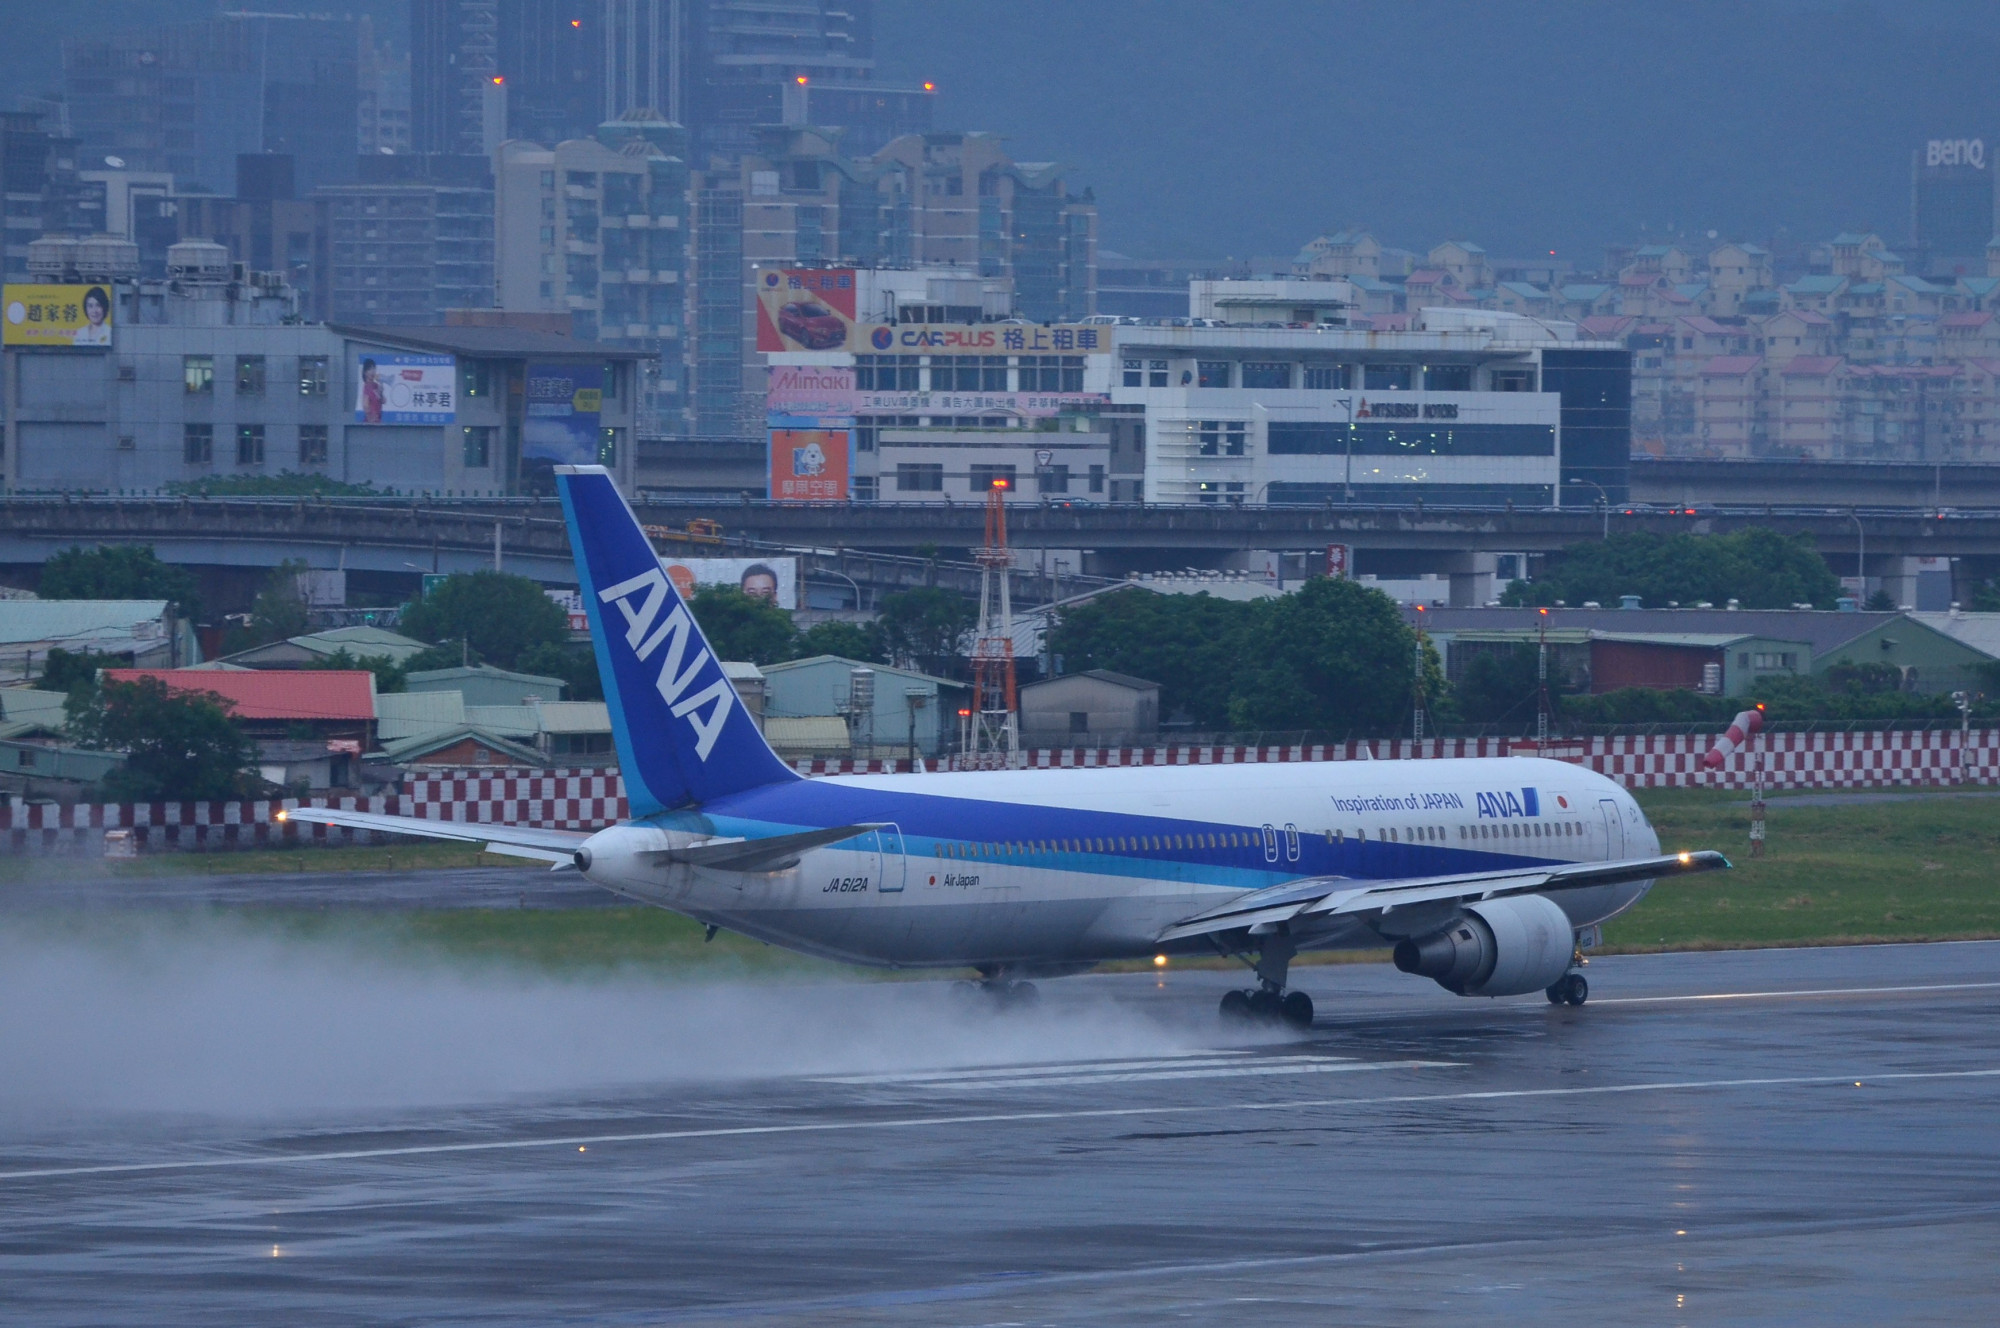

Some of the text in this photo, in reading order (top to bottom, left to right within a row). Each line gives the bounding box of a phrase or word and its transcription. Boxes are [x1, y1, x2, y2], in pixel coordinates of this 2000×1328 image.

[1927, 138, 1985, 169] BenQ
[788, 275, 852, 290] 格上租車
[901, 331, 996, 348] CARPLUS
[1003, 328, 1098, 350] 格上租車
[777, 372, 849, 390] Mimaki
[1371, 403, 1458, 418] MITSUBISHI MOTORS
[598, 567, 734, 763] ANA
[1331, 792, 1463, 815] Inspiration of JAPAN
[1476, 791, 1523, 818] ANA
[823, 877, 869, 893] JA612A
